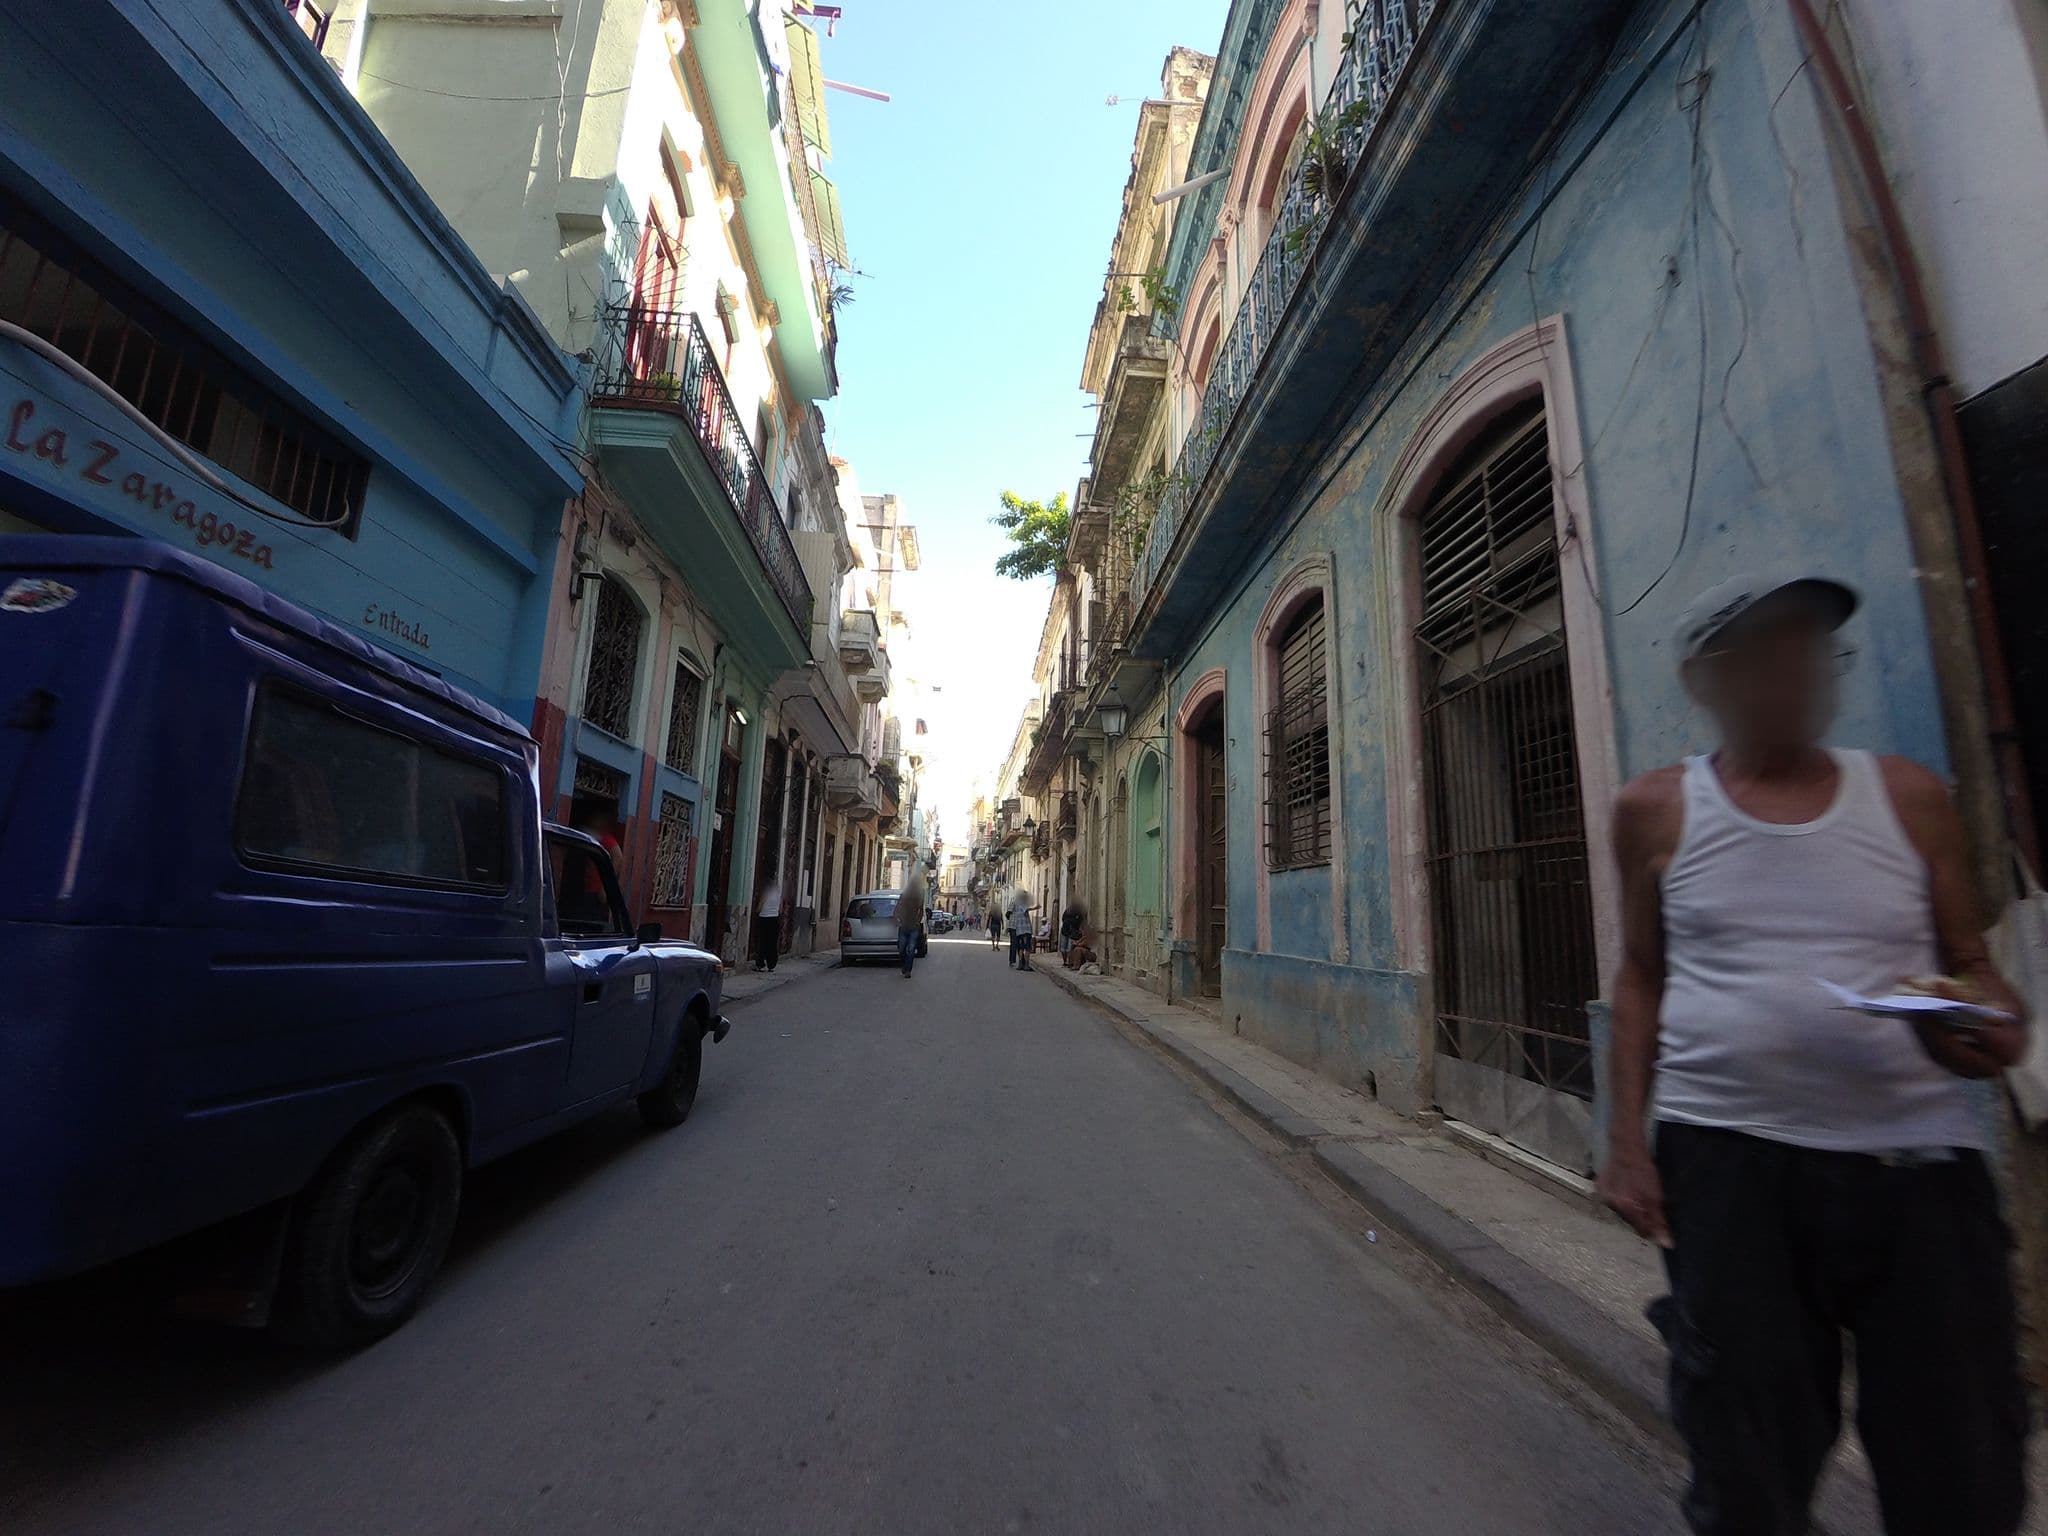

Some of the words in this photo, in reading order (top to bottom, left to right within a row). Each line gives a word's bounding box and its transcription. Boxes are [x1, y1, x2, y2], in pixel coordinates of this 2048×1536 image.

[5, 399, 67, 467] La
[81, 439, 273, 568] Zaragoza
[364, 603, 431, 649] Entrada
